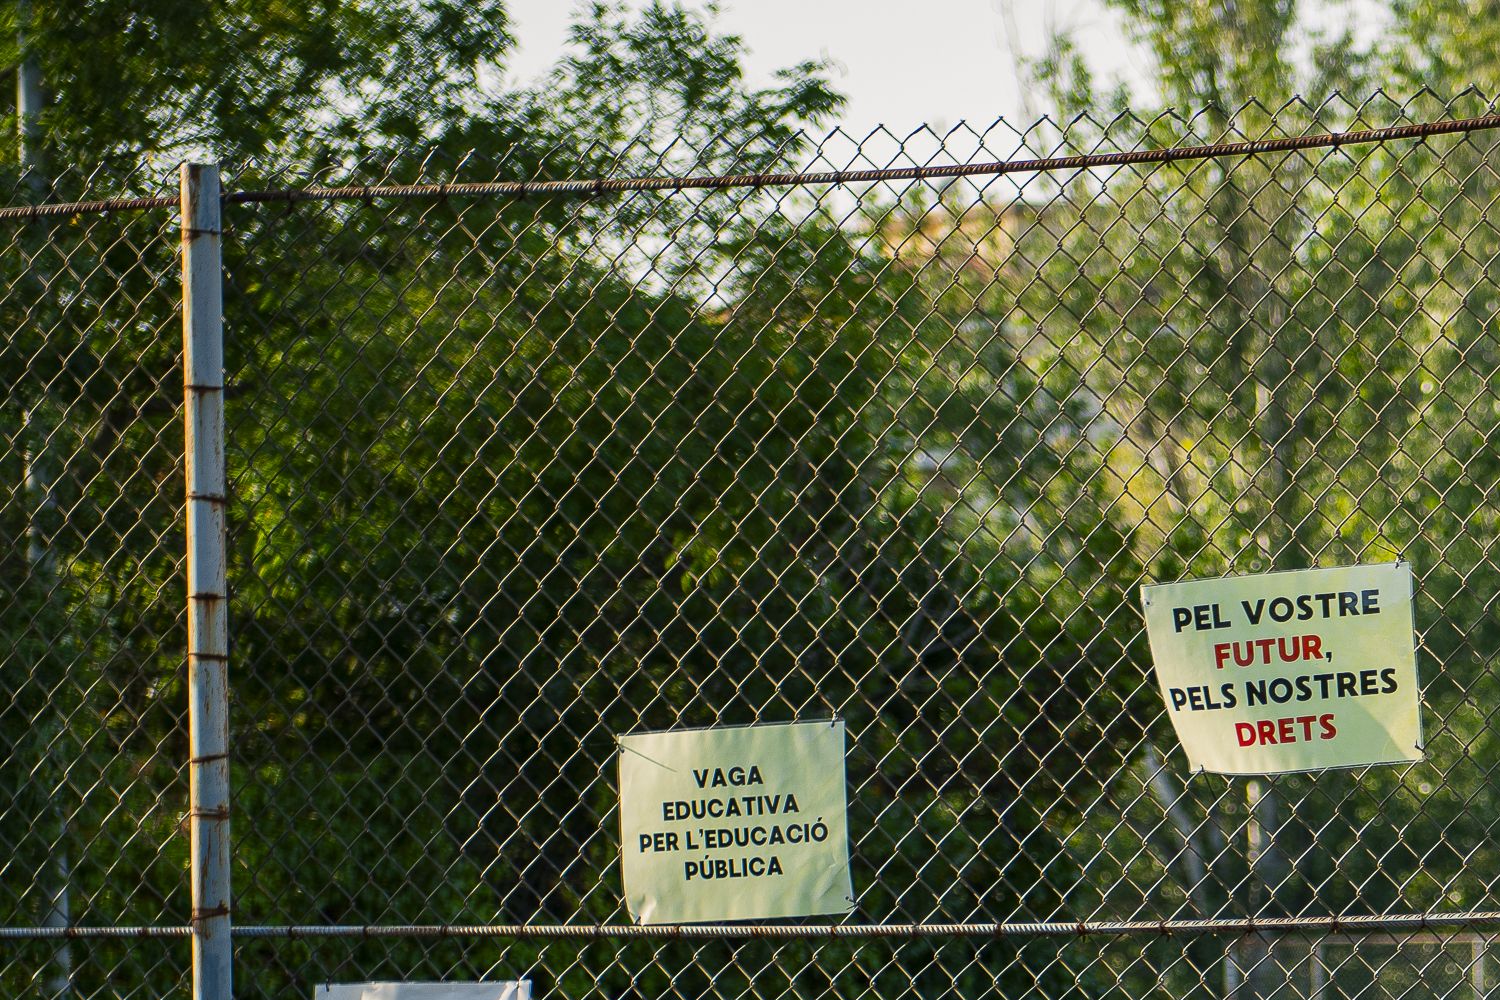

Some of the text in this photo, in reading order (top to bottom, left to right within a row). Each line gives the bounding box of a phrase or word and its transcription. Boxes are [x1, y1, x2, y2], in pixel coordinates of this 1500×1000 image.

[1172, 589, 1380, 633] PEL VOSTRE
[1214, 634, 1333, 670] FUTUR,
[1169, 668, 1398, 712] PELS NOSTRES
[1234, 714, 1337, 747] DRETS
[693, 765, 763, 788] VAGA
[663, 793, 799, 821] EDUCATIVA
[639, 817, 829, 853] PER L'EDUCACIÓ
[684, 855, 783, 881] PÚBLICA
